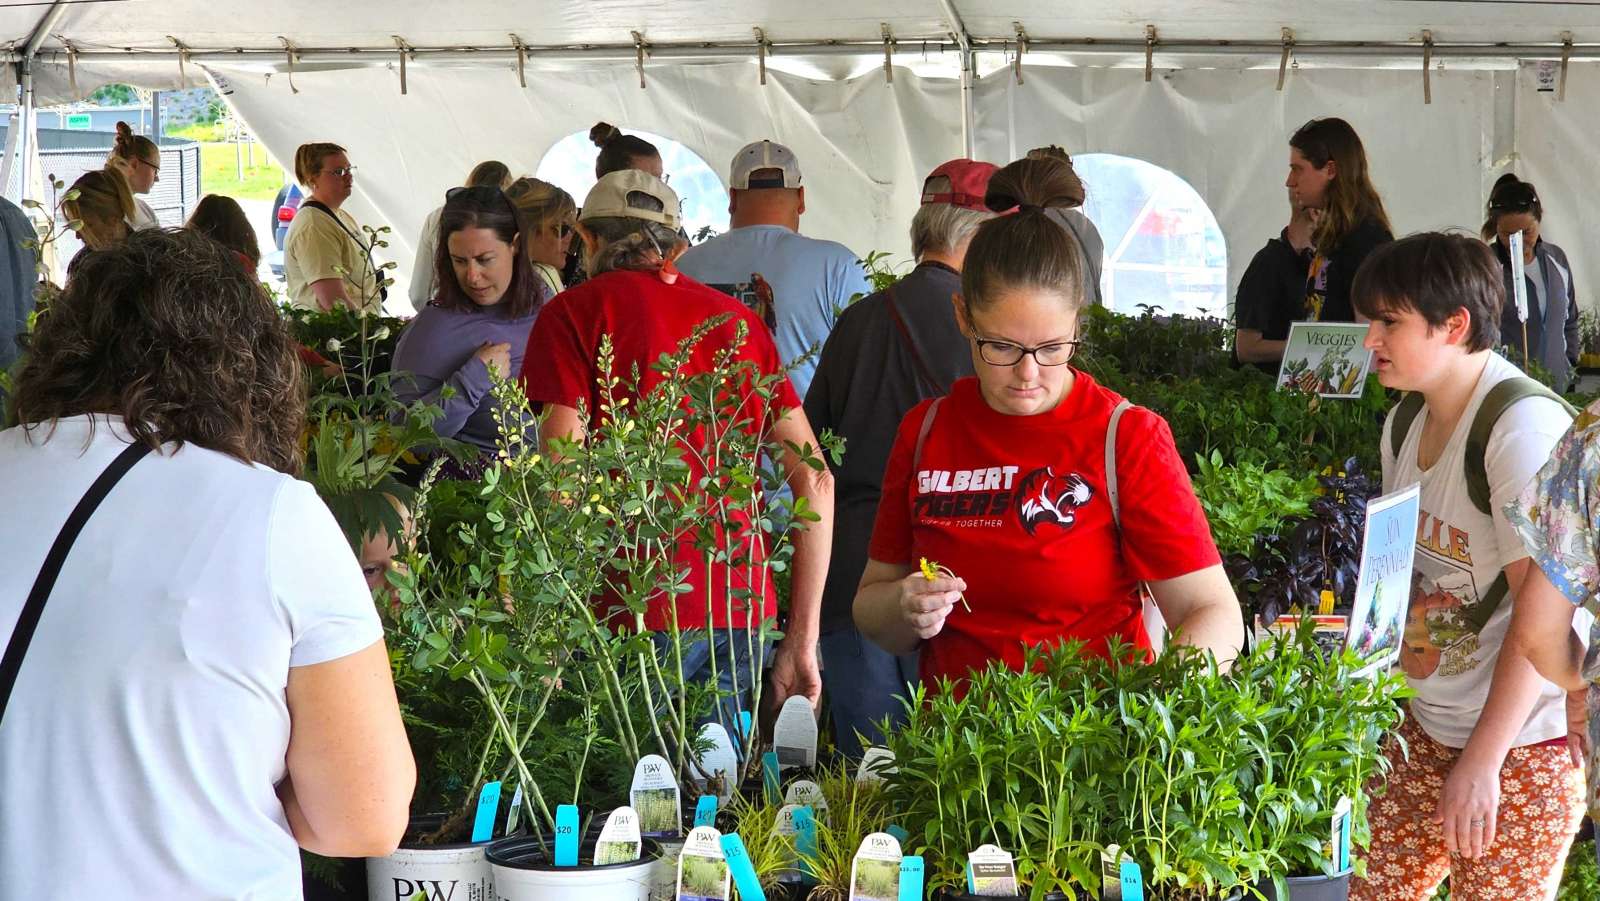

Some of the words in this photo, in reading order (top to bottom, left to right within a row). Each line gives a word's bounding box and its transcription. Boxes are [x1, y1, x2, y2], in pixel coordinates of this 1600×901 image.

[1306, 331, 1358, 346] VEGGIES
[917, 466, 1019, 493] GILBERT
[913, 492, 1013, 517] TIGERS
[956, 519, 1003, 528] TOGETHER
[557, 825, 572, 834] $20
[725, 846, 740, 858] $15
[392, 877, 459, 901] PW
